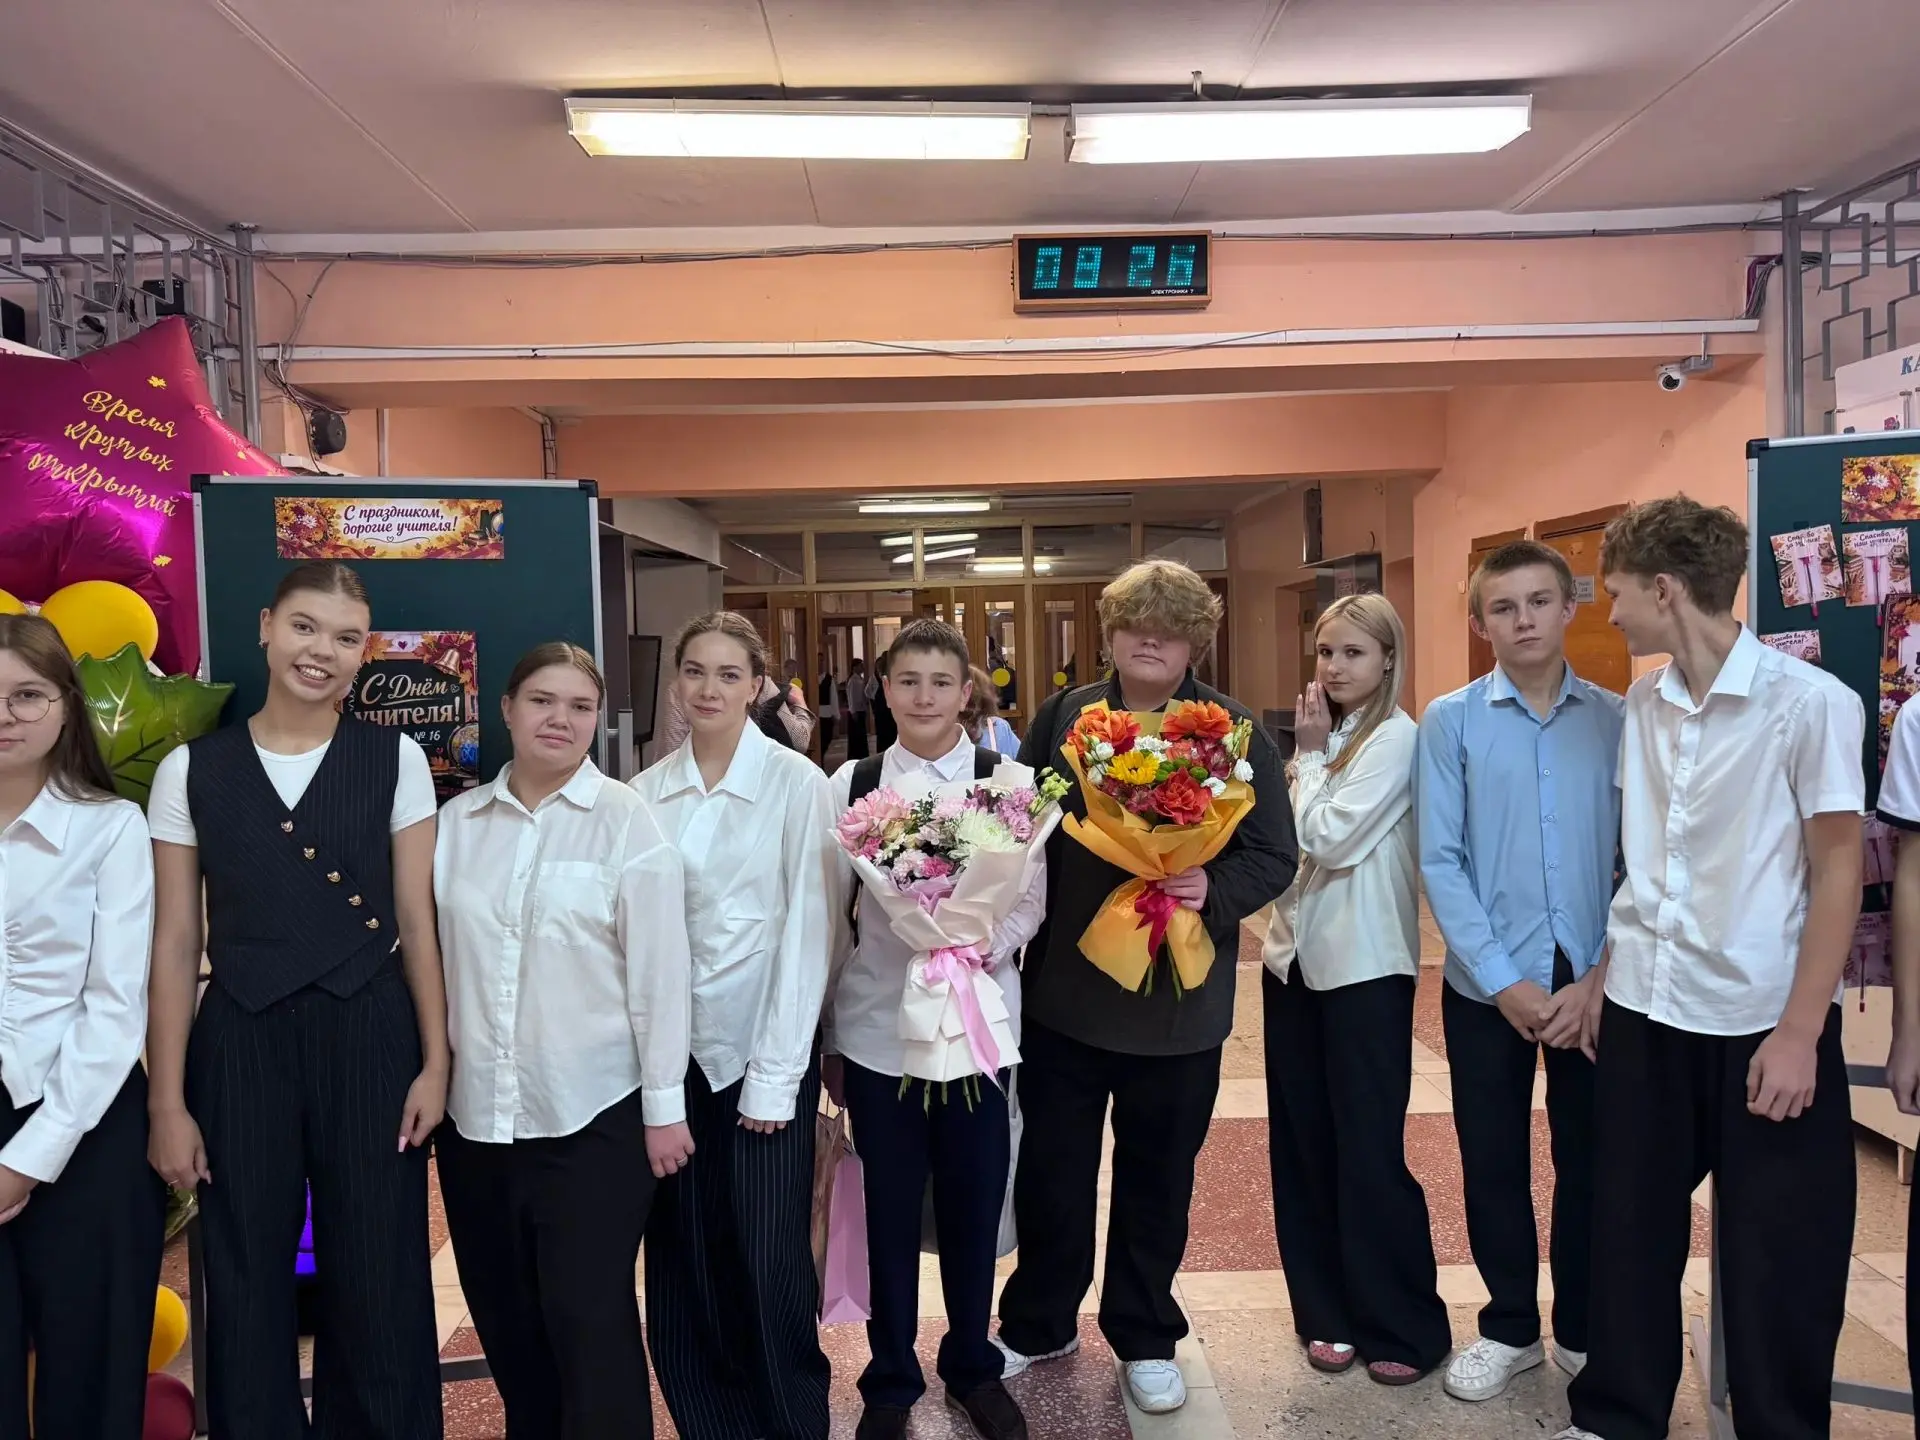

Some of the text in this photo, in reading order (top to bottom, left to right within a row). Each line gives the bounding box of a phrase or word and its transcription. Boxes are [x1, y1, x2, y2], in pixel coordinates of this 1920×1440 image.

[83, 391, 178, 438] Время
[64, 421, 174, 472] крутых
[28, 453, 179, 516] открытий
[343, 516, 458, 537] дорогие учителя!
[344, 505, 443, 522] С праздником,
[361, 673, 448, 705] С Днём
[429, 730, 441, 741] 16
